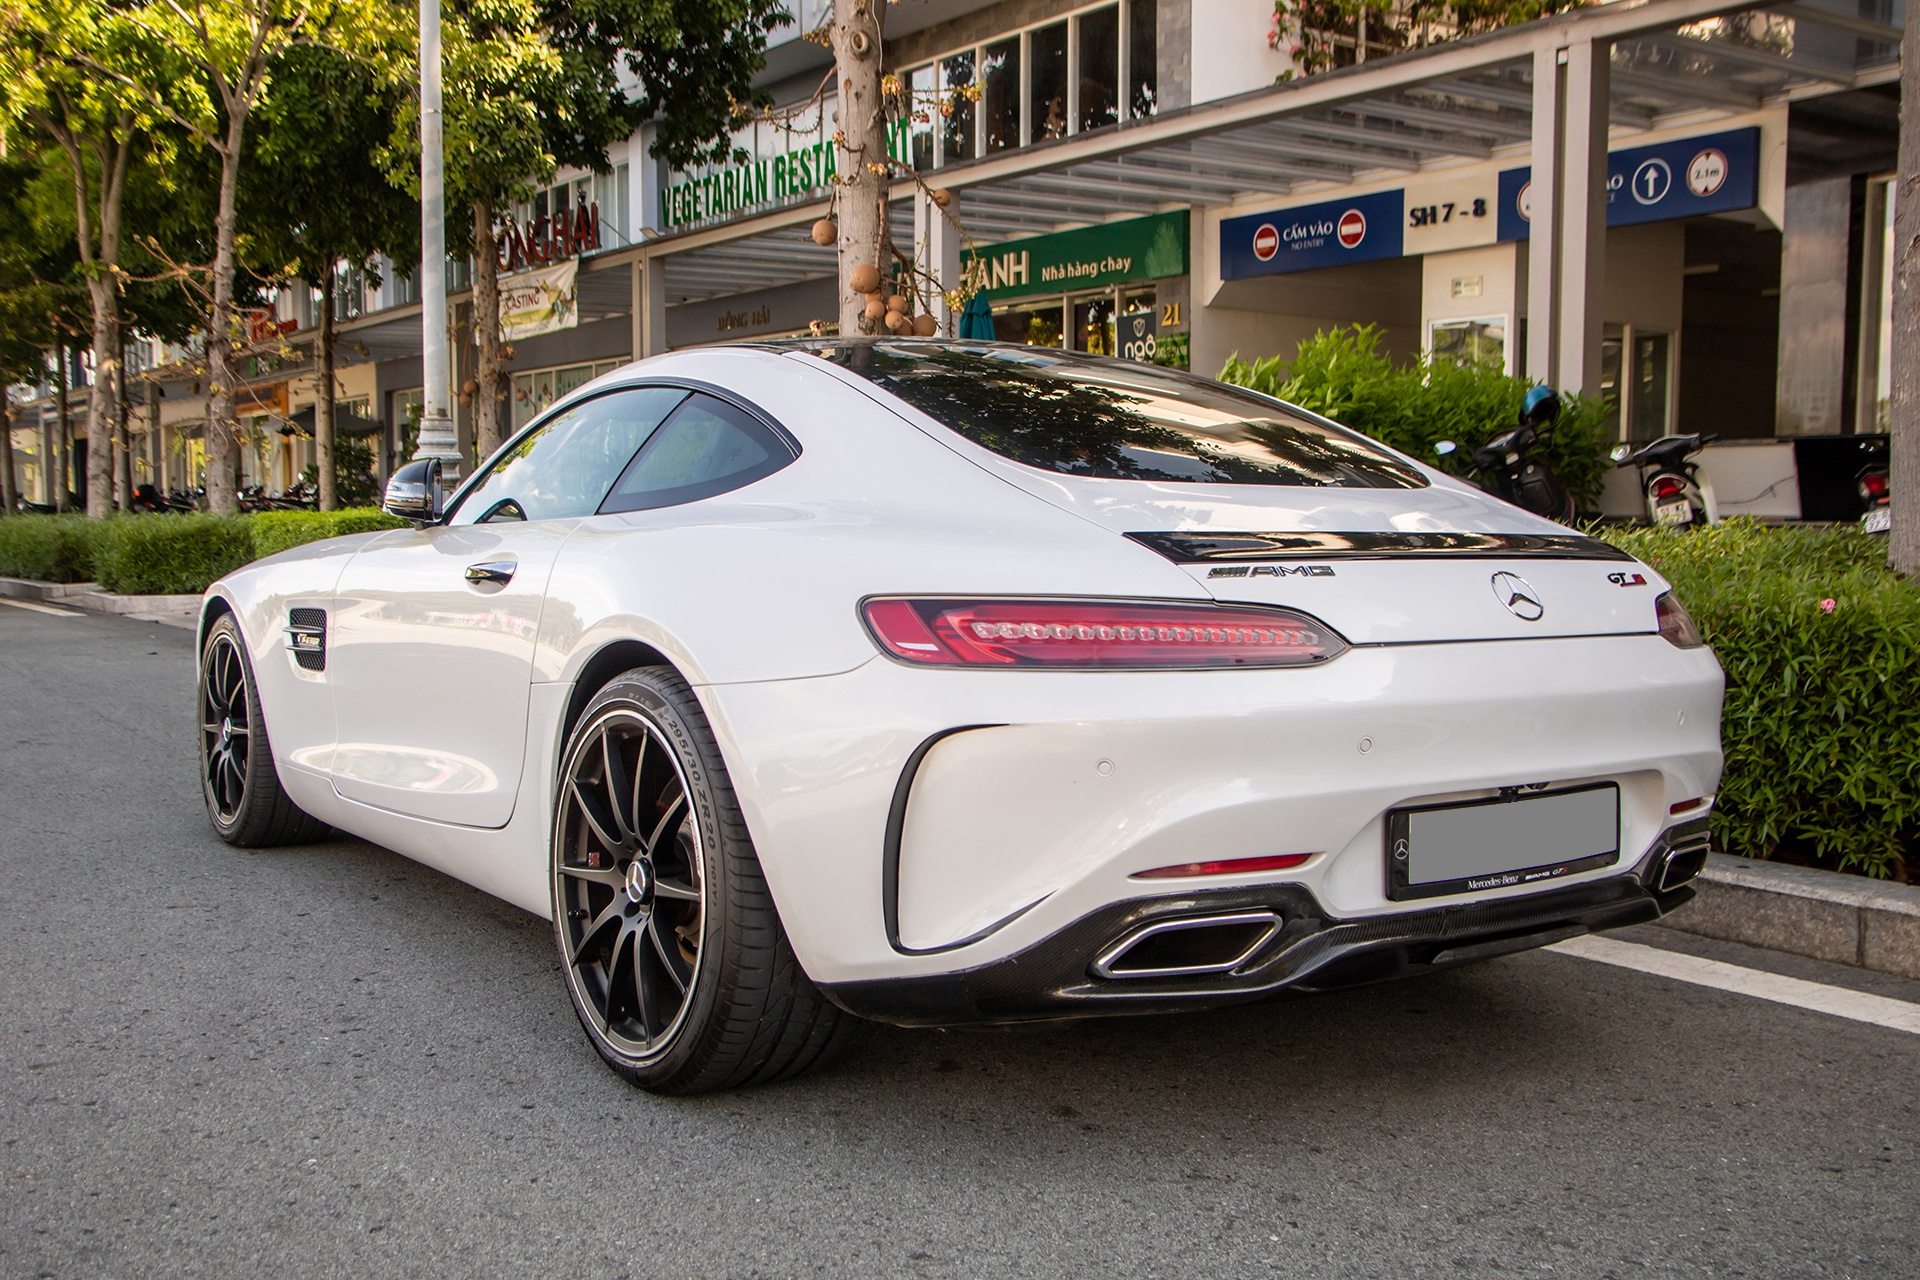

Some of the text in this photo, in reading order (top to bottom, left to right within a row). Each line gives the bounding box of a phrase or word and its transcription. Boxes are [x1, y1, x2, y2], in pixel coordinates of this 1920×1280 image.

[661, 117, 909, 228] VEGETARIAN RESTANT
[1409, 205, 1437, 227] SH
[1442, 203, 1454, 222] 7
[1472, 198, 1487, 217] 8
[1283, 219, 1334, 242] CẤM VÀO
[1291, 238, 1325, 251] NO ENTRY
[1042, 263, 1066, 282] Nhà
[1067, 260, 1098, 278] hàng
[1100, 255, 1132, 274] chay
[1161, 302, 1182, 327] 21
[1248, 565, 1336, 578] AMG
[1468, 875, 1520, 890] Mercedes-Benz
